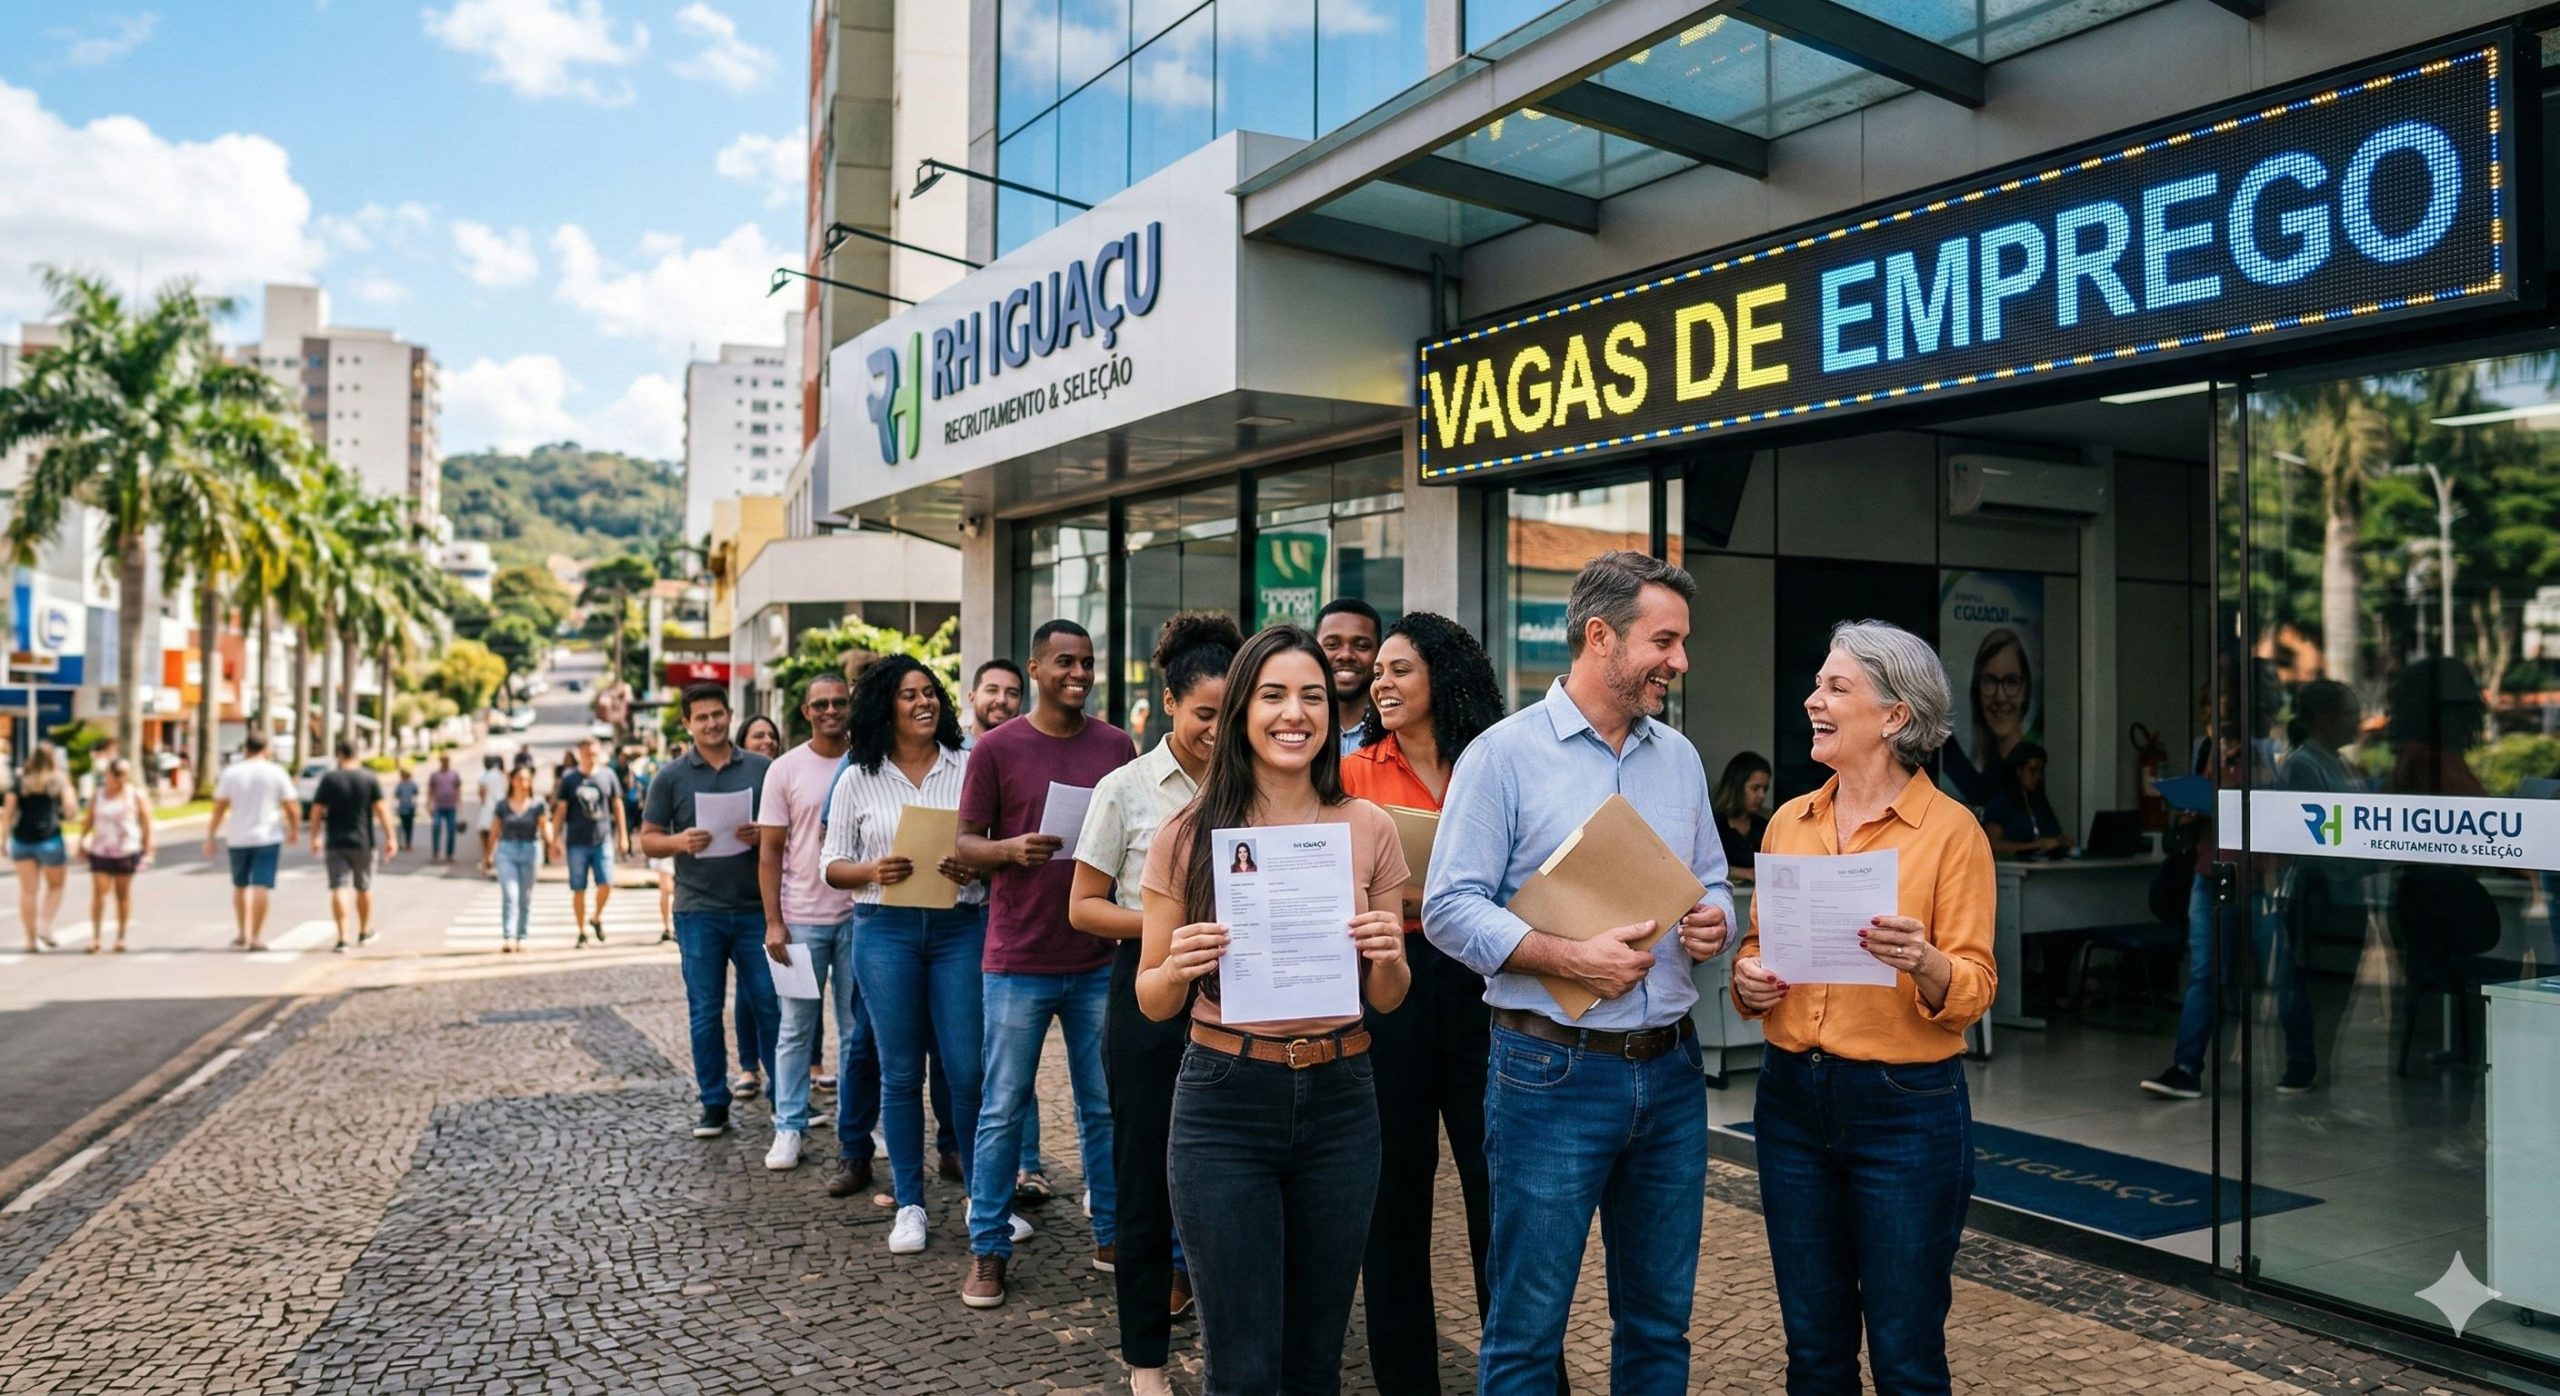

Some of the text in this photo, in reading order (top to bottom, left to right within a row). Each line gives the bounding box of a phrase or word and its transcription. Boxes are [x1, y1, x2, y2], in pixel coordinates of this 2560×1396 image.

[931, 221, 1161, 401] RH IGUAÇU
[1427, 119, 2463, 450] VAGAS DE EMPREGO
[944, 352, 1133, 446] RECRUTAMENTO & SELEÇÃO
[2354, 806, 2523, 844] RH IGUAÇU
[2370, 839, 2524, 859] RECRUTAMENTO & SELEÇÃO
